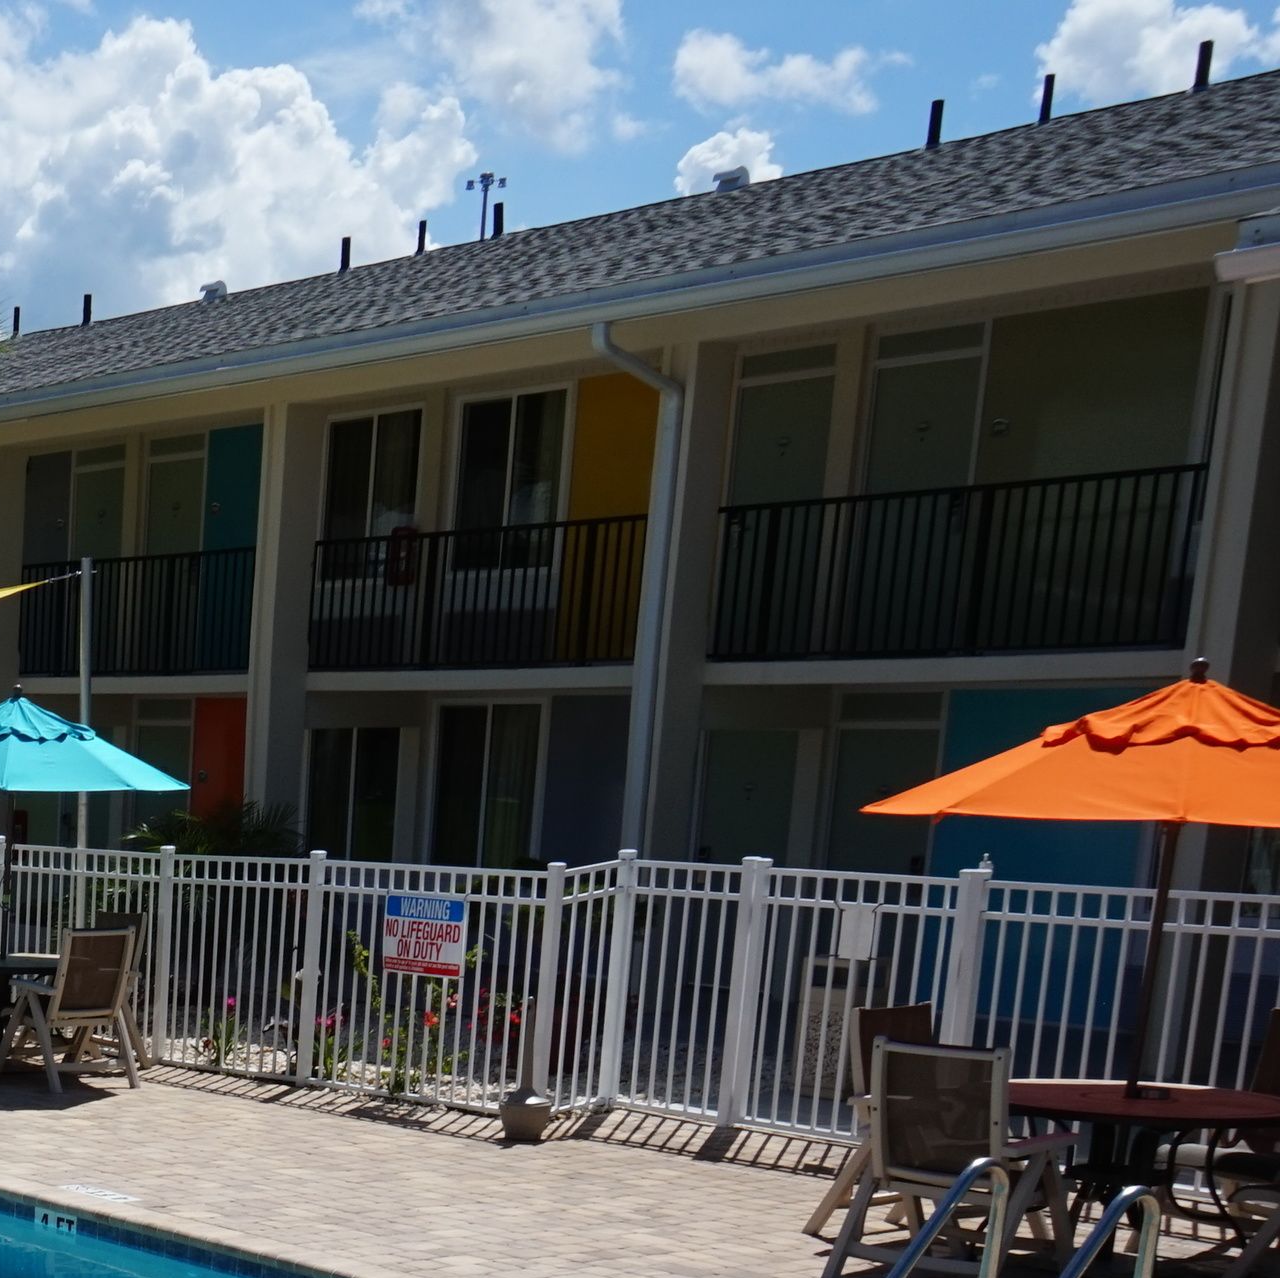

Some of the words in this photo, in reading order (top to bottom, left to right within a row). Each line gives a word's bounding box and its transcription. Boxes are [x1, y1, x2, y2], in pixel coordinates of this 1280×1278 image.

[400, 897, 451, 920] WARNING
[385, 919, 399, 937] NO
[401, 920, 461, 943] LIFEGUARD
[397, 939, 411, 957] ON
[413, 941, 443, 961] DUTY
[56, 1216, 75, 1232] FT
